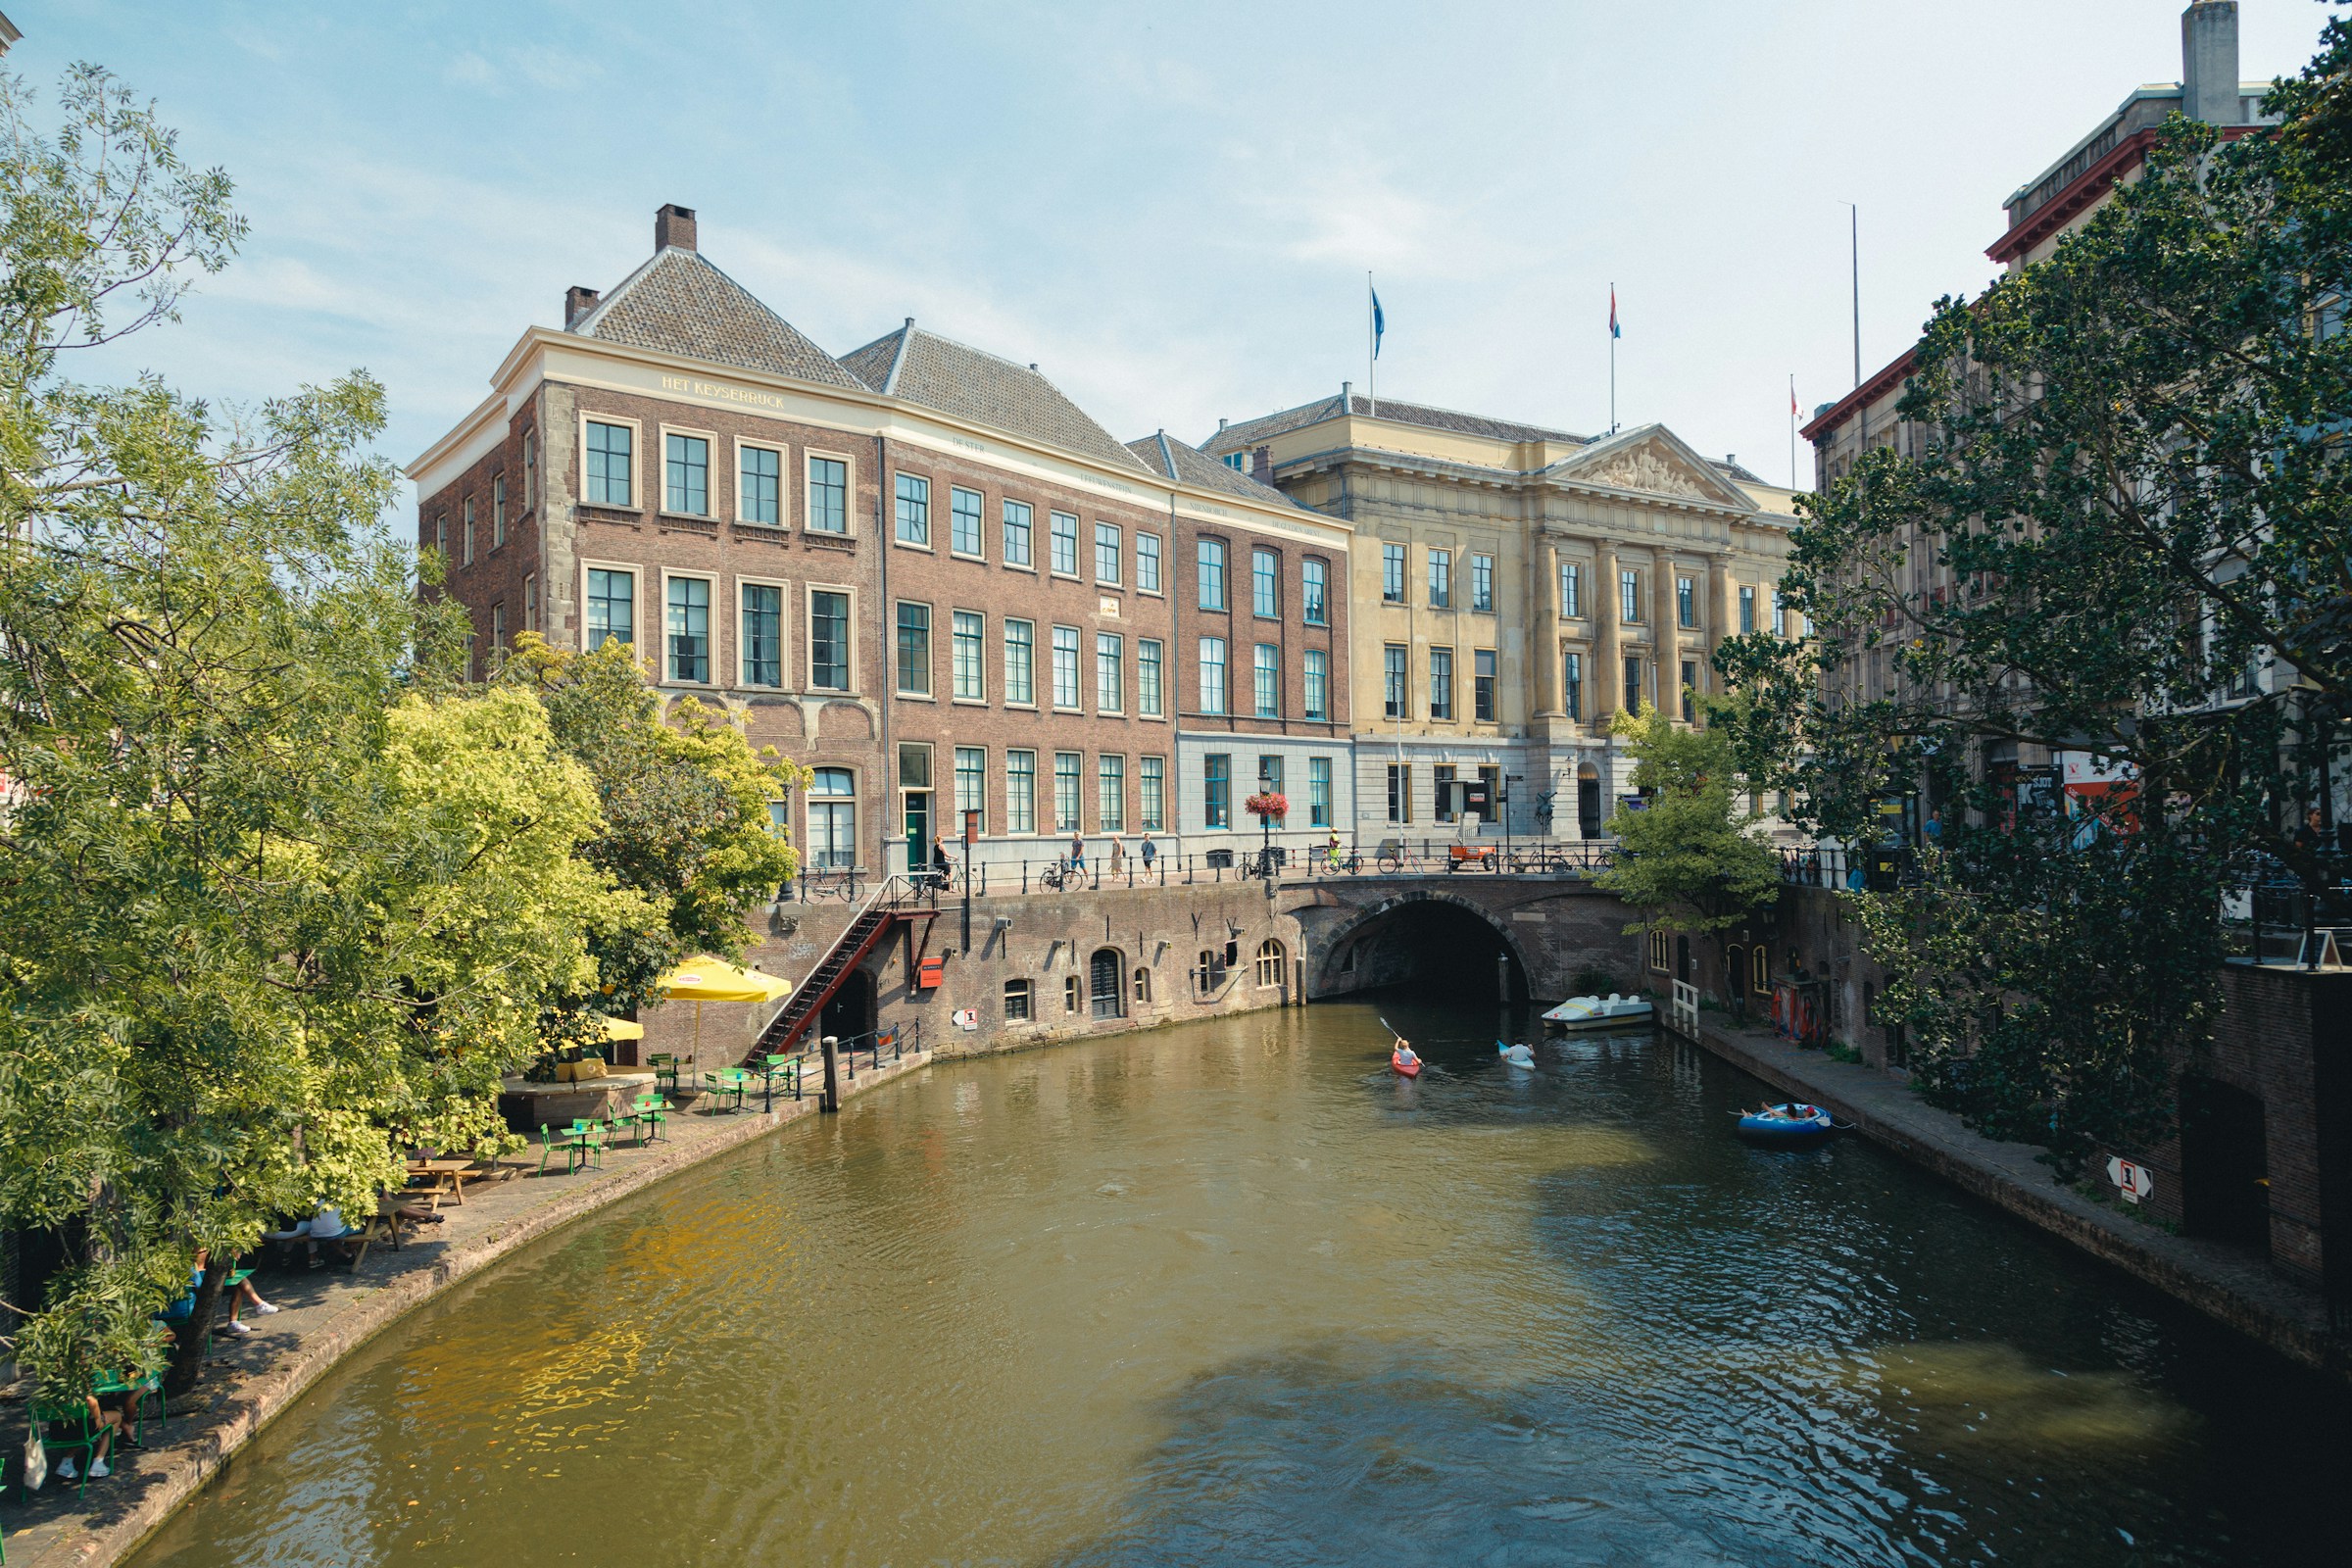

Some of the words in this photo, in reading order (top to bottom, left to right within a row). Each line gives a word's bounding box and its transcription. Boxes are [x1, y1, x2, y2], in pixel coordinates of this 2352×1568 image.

[662, 375, 691, 392] HET
[953, 436, 963, 448] DE
[965, 440, 985, 454] STER
